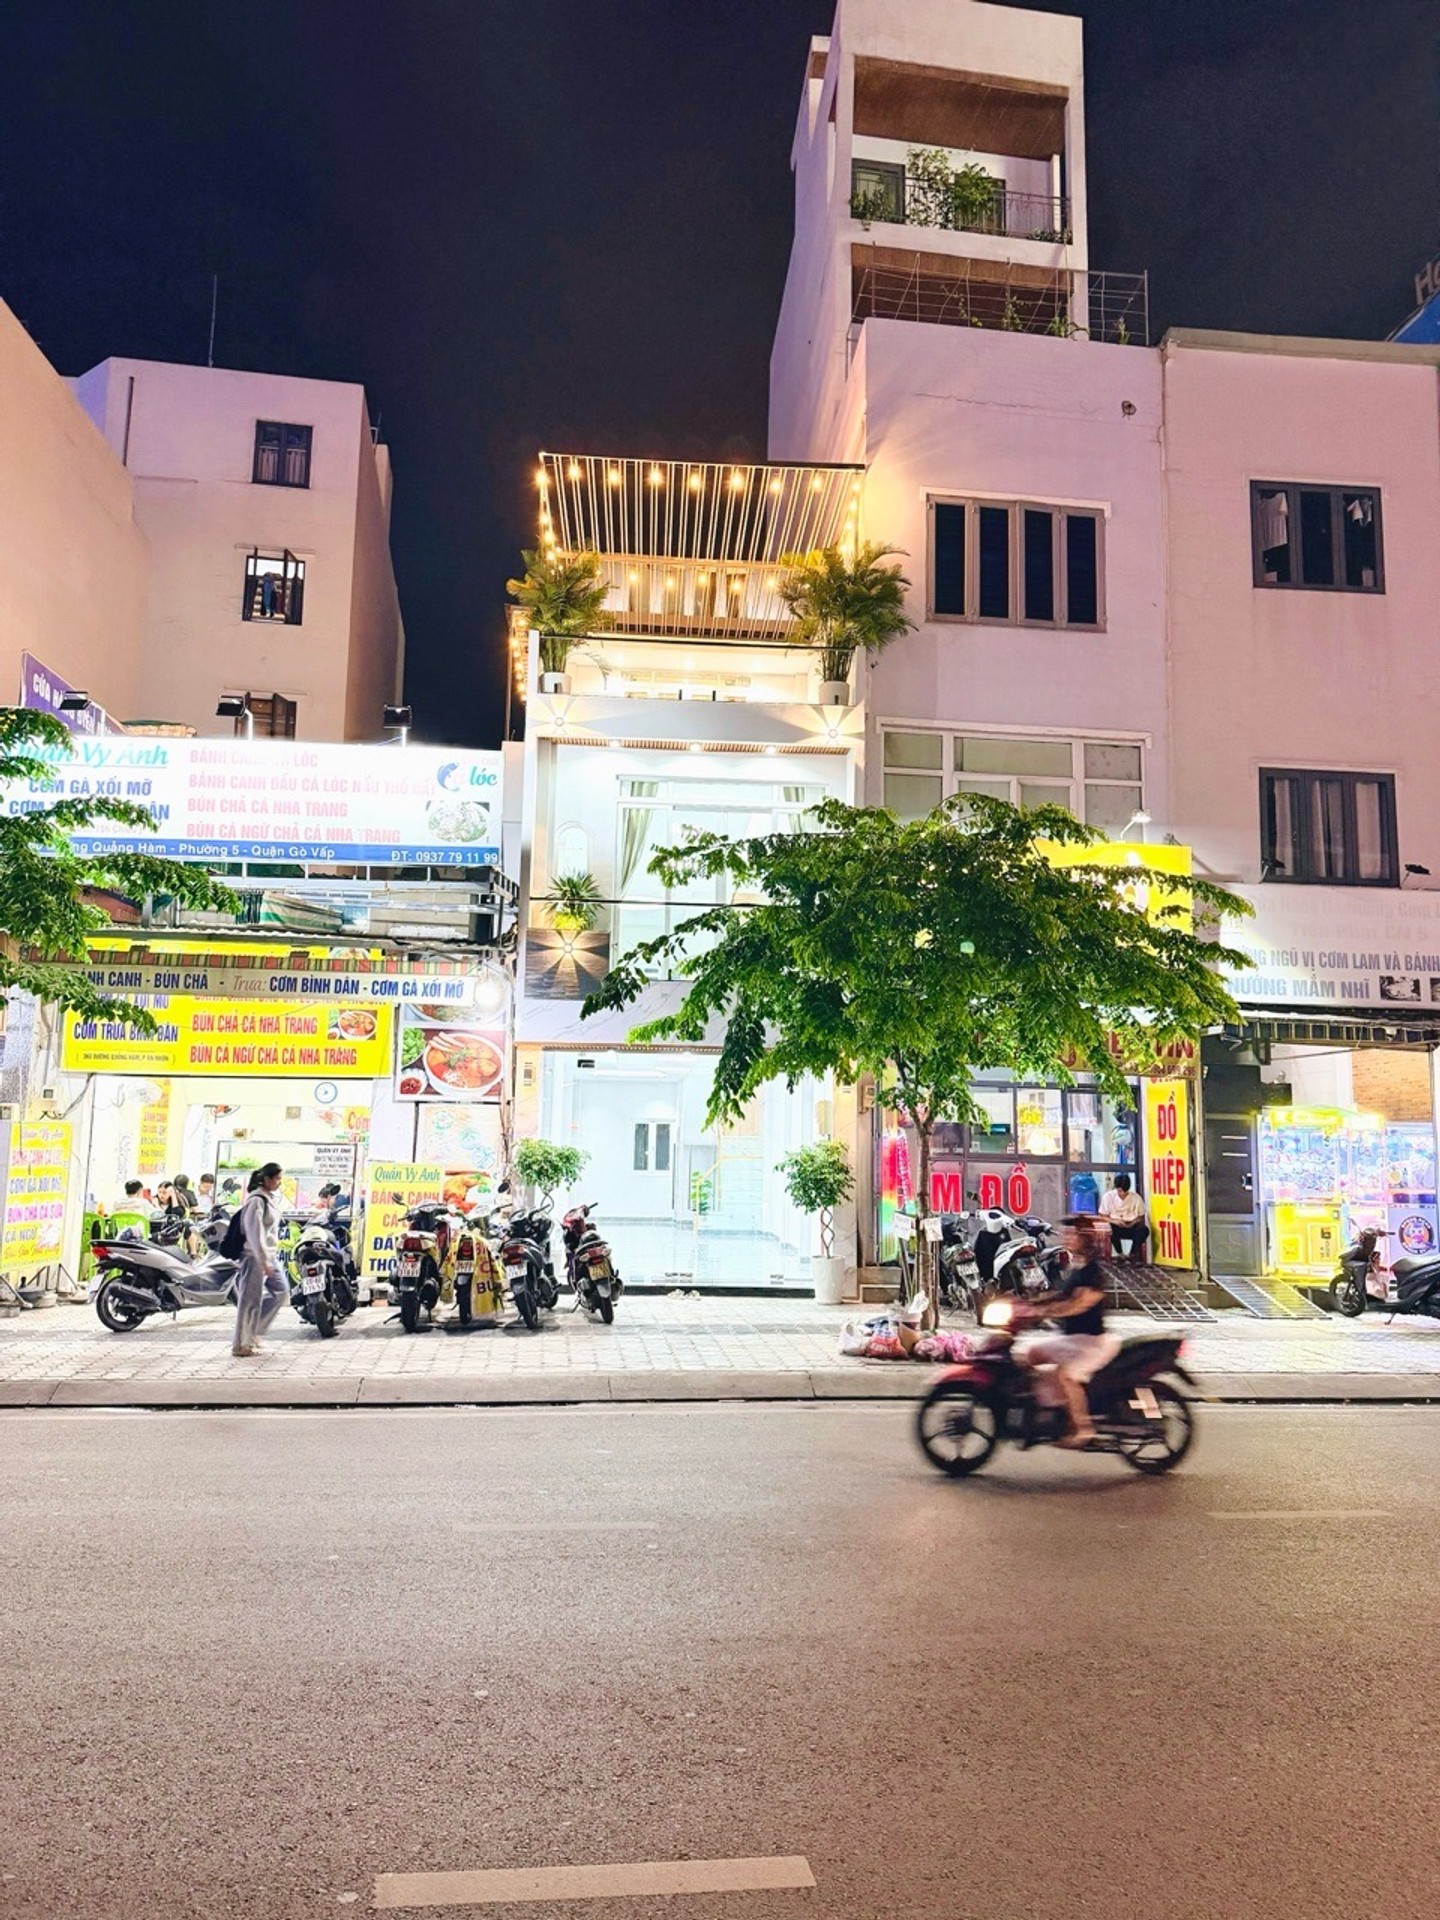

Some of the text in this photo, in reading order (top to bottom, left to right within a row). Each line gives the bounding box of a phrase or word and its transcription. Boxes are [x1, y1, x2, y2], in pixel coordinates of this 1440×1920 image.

[82, 742, 111, 768] Vy
[190, 748, 226, 764] BÁNH
[294, 752, 318, 767] LÓC
[70, 777, 90, 794] GÀ
[189, 771, 225, 789] BÁNH
[230, 776, 266, 790] CANH
[301, 774, 319, 791] CÁ
[324, 776, 348, 793] LÓC
[469, 766, 498, 786] lóc
[188, 795, 348, 817] BÚN CHẢ CÁ NHA TRANG
[186, 820, 214, 838] BÚN
[219, 821, 237, 839] CÁ
[274, 821, 300, 841] CHẢ
[304, 823, 321, 842] CÁ
[326, 827, 353, 842] NHA
[358, 828, 400, 843] TRANG
[92, 839, 133, 855] Quảng
[138, 841, 166, 853] Hàm
[179, 843, 228, 857] Phường
[232, 845, 239, 855] 5
[251, 845, 284, 857] Quận
[289, 847, 307, 857] Gò
[311, 847, 335, 860] Vấp
[391, 851, 498, 863] ĐT: 0937 79 11 99
[1302, 951, 1315, 971] VỊ
[1319, 950, 1349, 969] CƠM
[1352, 953, 1380, 970] LAM
[1384, 950, 1400, 971] VÀ
[1405, 952, 1440, 972] BÁNH
[108, 971, 142, 987] CANH
[154, 969, 179, 988] BÚN
[183, 968, 208, 989] CHẢ
[269, 975, 297, 992] CƠM
[301, 974, 330, 994] BÌNH
[333, 976, 360, 995] DÂN
[371, 979, 398, 996] CƠM
[402, 980, 418, 997] GÀ
[421, 978, 441, 998] XỐI
[444, 981, 464, 998] MỠ
[192, 1010, 318, 1034] BÚN CHẢ CÁ NHA TRANG
[190, 1042, 212, 1063] BÚN
[215, 1042, 229, 1063] CÁ
[258, 1041, 278, 1064] CHẢ
[282, 1044, 295, 1064] CÁ
[299, 1047, 319, 1065] NHA
[1157, 1090, 1178, 1141] ĐỒ
[375, 1167, 401, 1182] Quán
[405, 1168, 418, 1183] Vy
[1152, 1150, 1185, 1205] HIỆP
[980, 1162, 1032, 1216] ĐỒ
[383, 1211, 399, 1228] CÁ
[1158, 1213, 1183, 1260] TÍN
